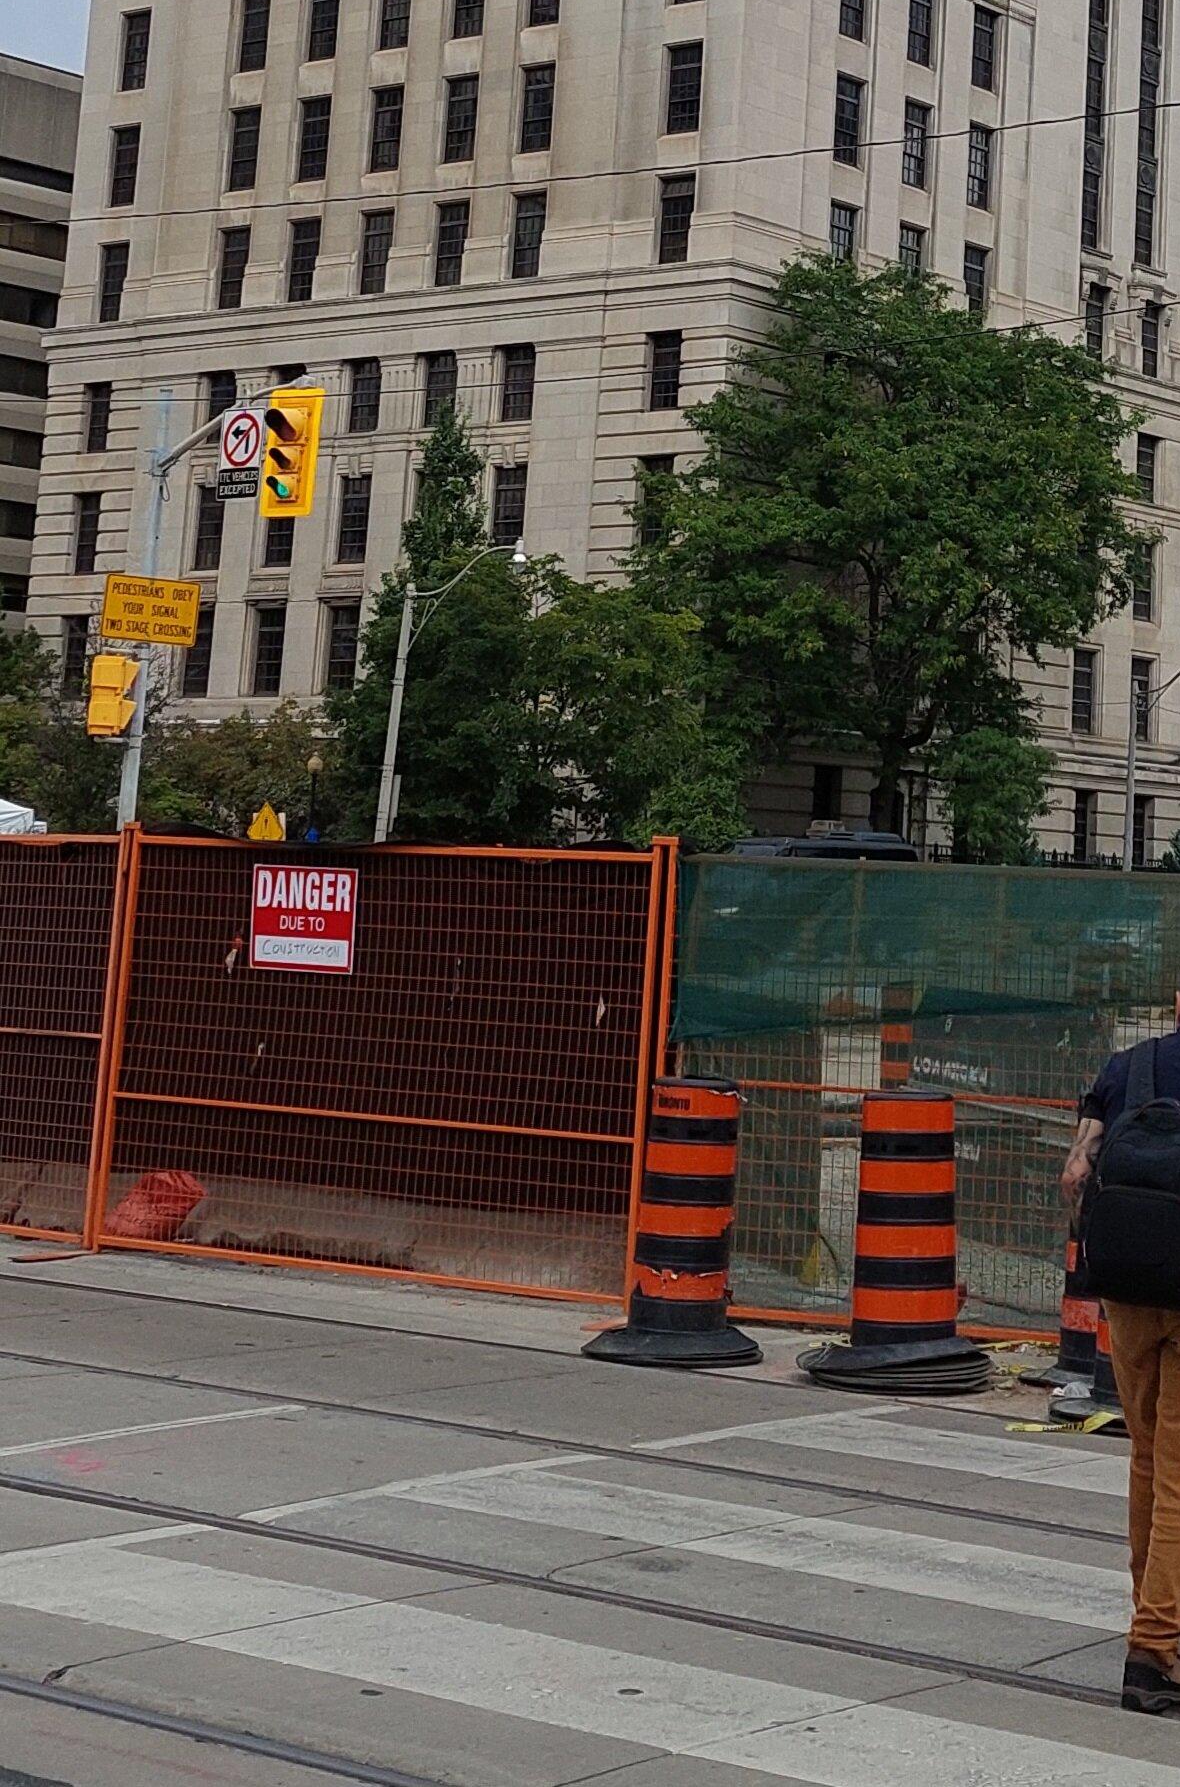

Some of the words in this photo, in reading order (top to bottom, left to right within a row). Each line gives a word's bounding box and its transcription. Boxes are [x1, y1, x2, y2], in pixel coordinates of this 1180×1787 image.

[220, 483, 256, 496] EXCEPTED
[112, 582, 165, 599] PEDESTRIANS
[172, 588, 194, 602] OBEY
[122, 601, 145, 615] YOUR
[152, 604, 179, 619] SIGNAL
[106, 618, 122, 632] TWO
[126, 620, 150, 635] STAGE
[153, 622, 192, 638] CROSSING
[256, 870, 352, 912] DANGER
[280, 915, 305, 931] DUE
[308, 916, 325, 932] TO
